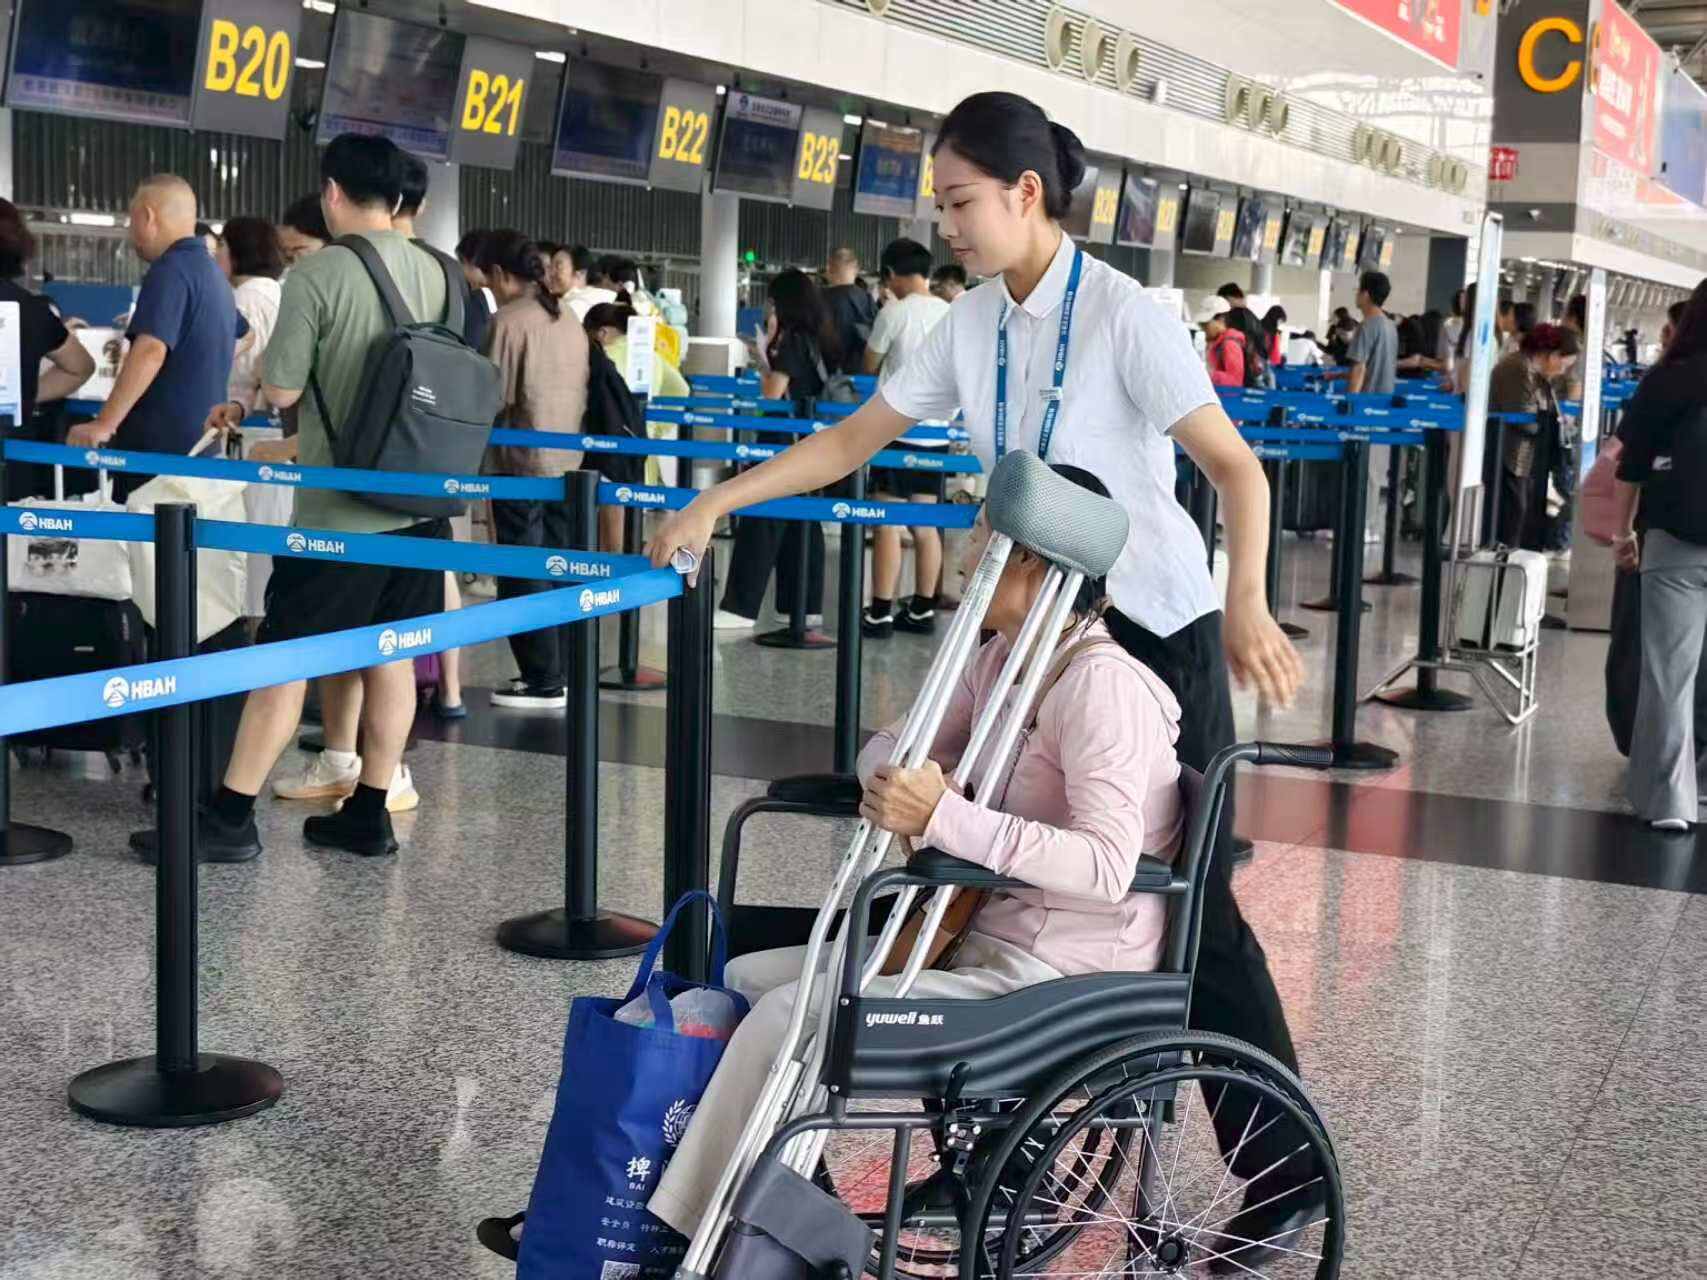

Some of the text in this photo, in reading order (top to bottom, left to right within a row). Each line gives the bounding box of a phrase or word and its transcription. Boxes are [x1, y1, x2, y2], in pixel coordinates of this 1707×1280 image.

[206, 20, 290, 101] B20
[1518, 17, 1583, 93] C
[462, 70, 524, 137] B21
[659, 106, 709, 165] B22
[799, 132, 839, 185] B23
[273, 471, 302, 482] HBAH
[459, 483, 490, 493] HBAH
[632, 491, 666, 504] HBAH
[851, 507, 886, 519] HBAH
[38, 517, 73, 531] HBAH
[307, 540, 345, 554] HBAH
[568, 562, 611, 577] HBAH
[592, 588, 621, 607] HBAH
[396, 627, 432, 650] HBAH
[130, 675, 177, 701] HBAH
[865, 1011, 917, 1028] yuwell
